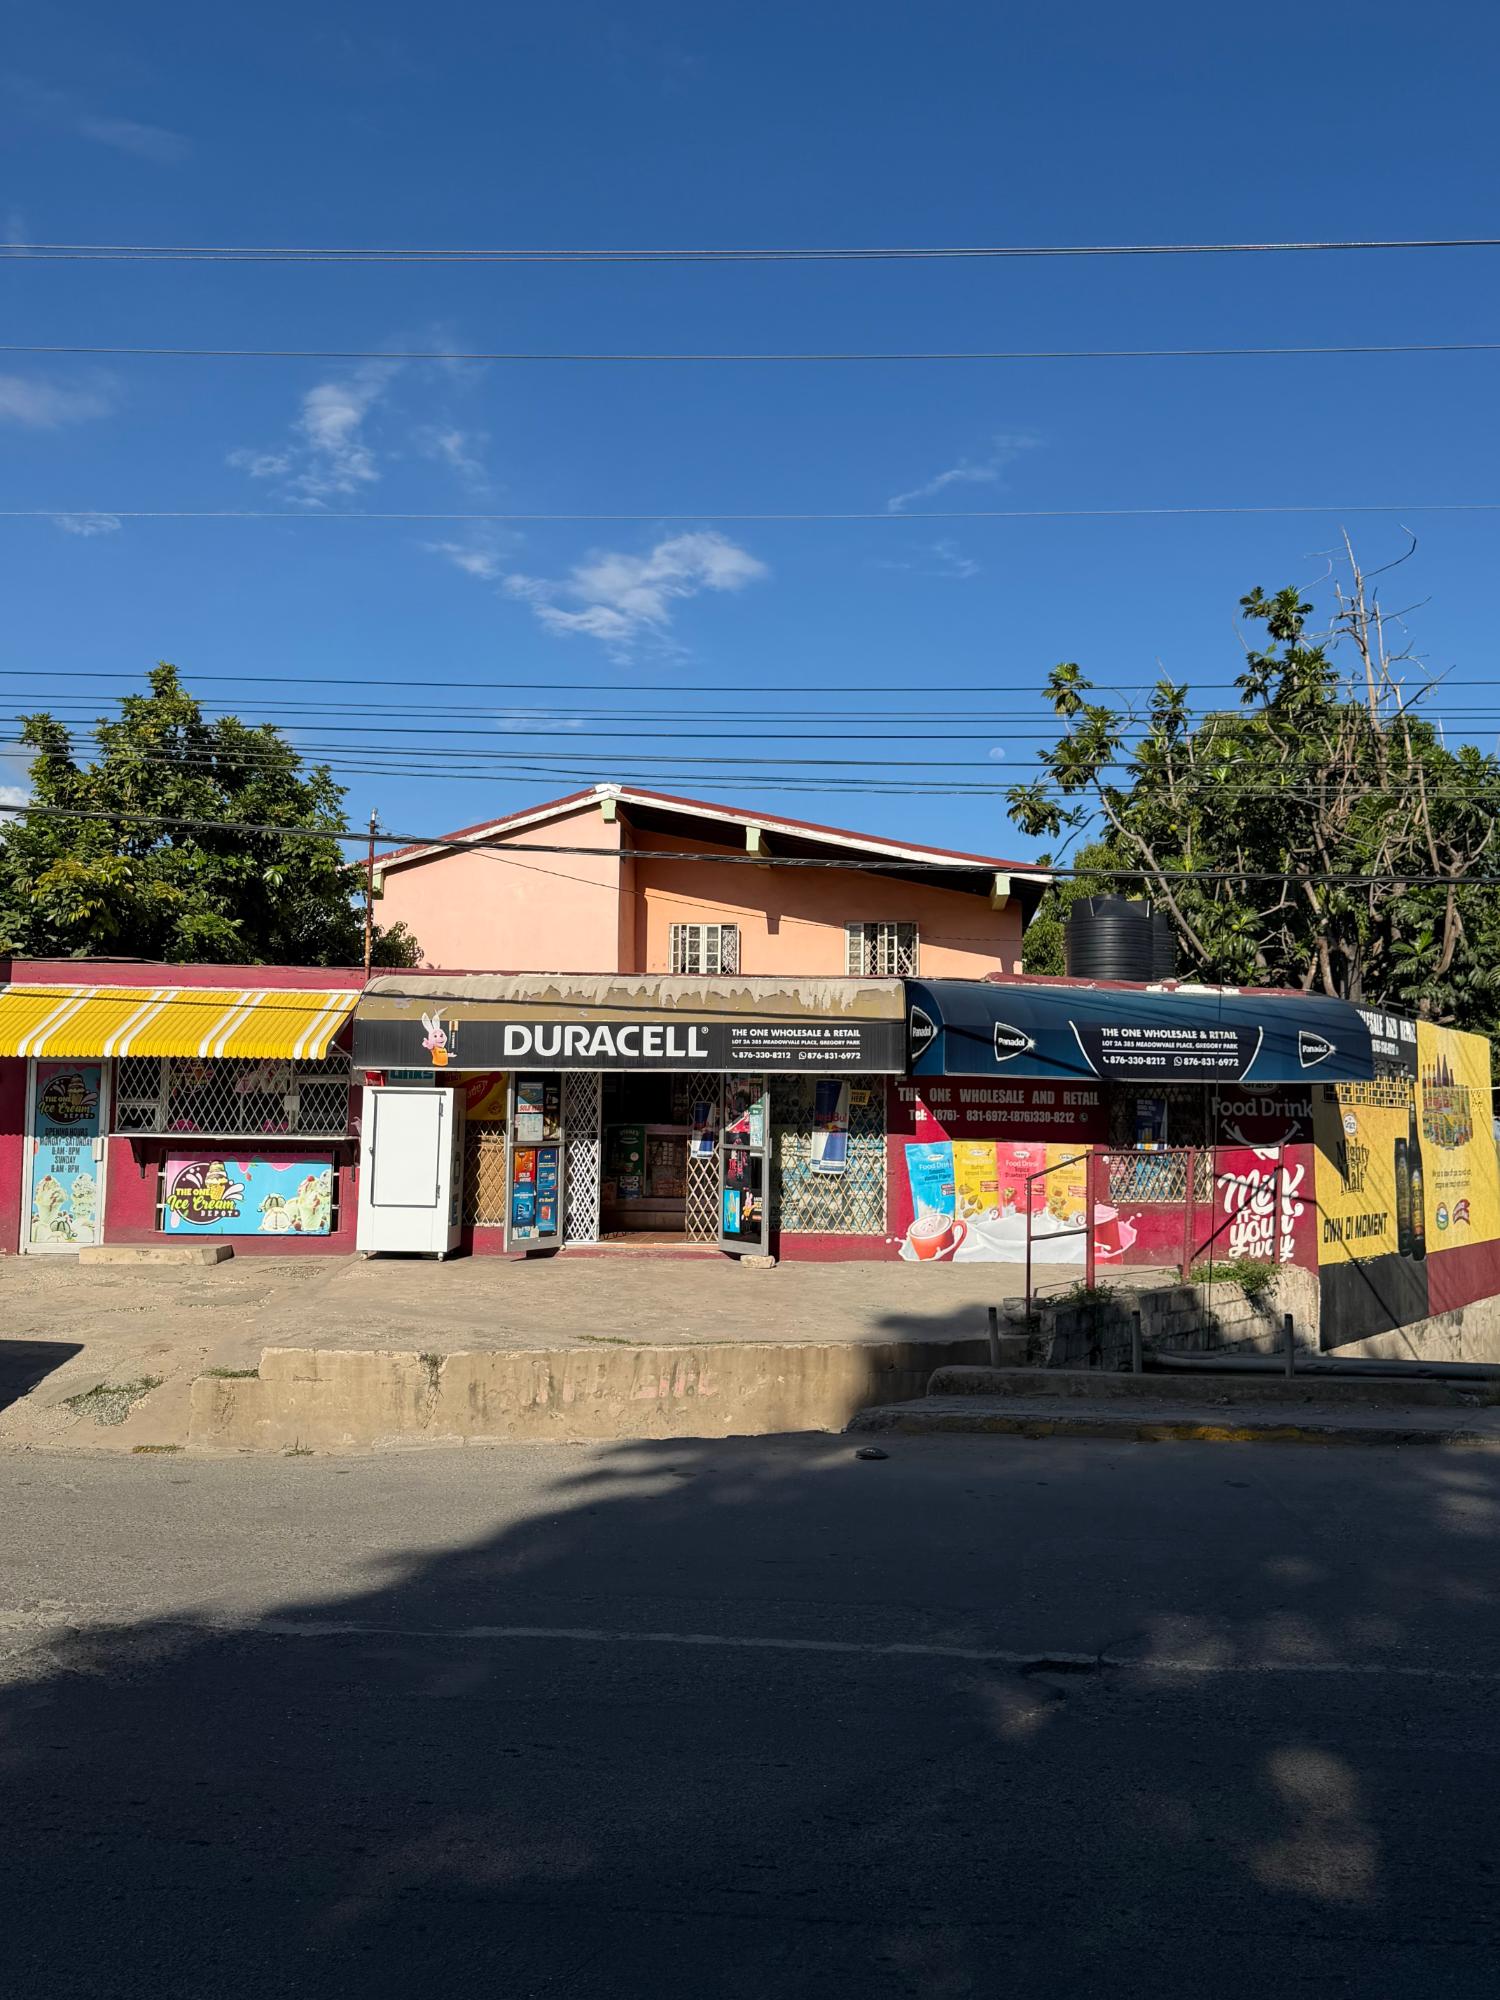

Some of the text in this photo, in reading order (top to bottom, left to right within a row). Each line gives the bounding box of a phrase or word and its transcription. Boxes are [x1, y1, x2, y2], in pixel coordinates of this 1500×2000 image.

[771, 1029, 821, 1037] WHOLESALE
[824, 1029, 831, 1037] &
[833, 1029, 860, 1037] RETAIL
[912, 1026, 931, 1037] Panadol
[1101, 1028, 1238, 1040] THE ONE WHOLESALE & RETAIL
[504, 1025, 709, 1057] DURACELL
[998, 1037, 1025, 1046] Panadol
[1110, 1056, 1239, 1067] 876-330-8212 876-831-6972
[898, 1087, 1100, 1105] THE ONE WHOLESALE AND RETAIL
[39, 1101, 90, 1114] Ice Cream
[1211, 1097, 1313, 1117] Food Drink
[909, 1109, 927, 1121] Tel:
[45, 1128, 88, 1136] OPENING HOURS
[54, 1156, 76, 1164] SUNDAY
[175, 1188, 211, 1196] THE ONE
[167, 1195, 234, 1212] Ice Cream
[1324, 1212, 1388, 1243] OWN DI MOMENT
